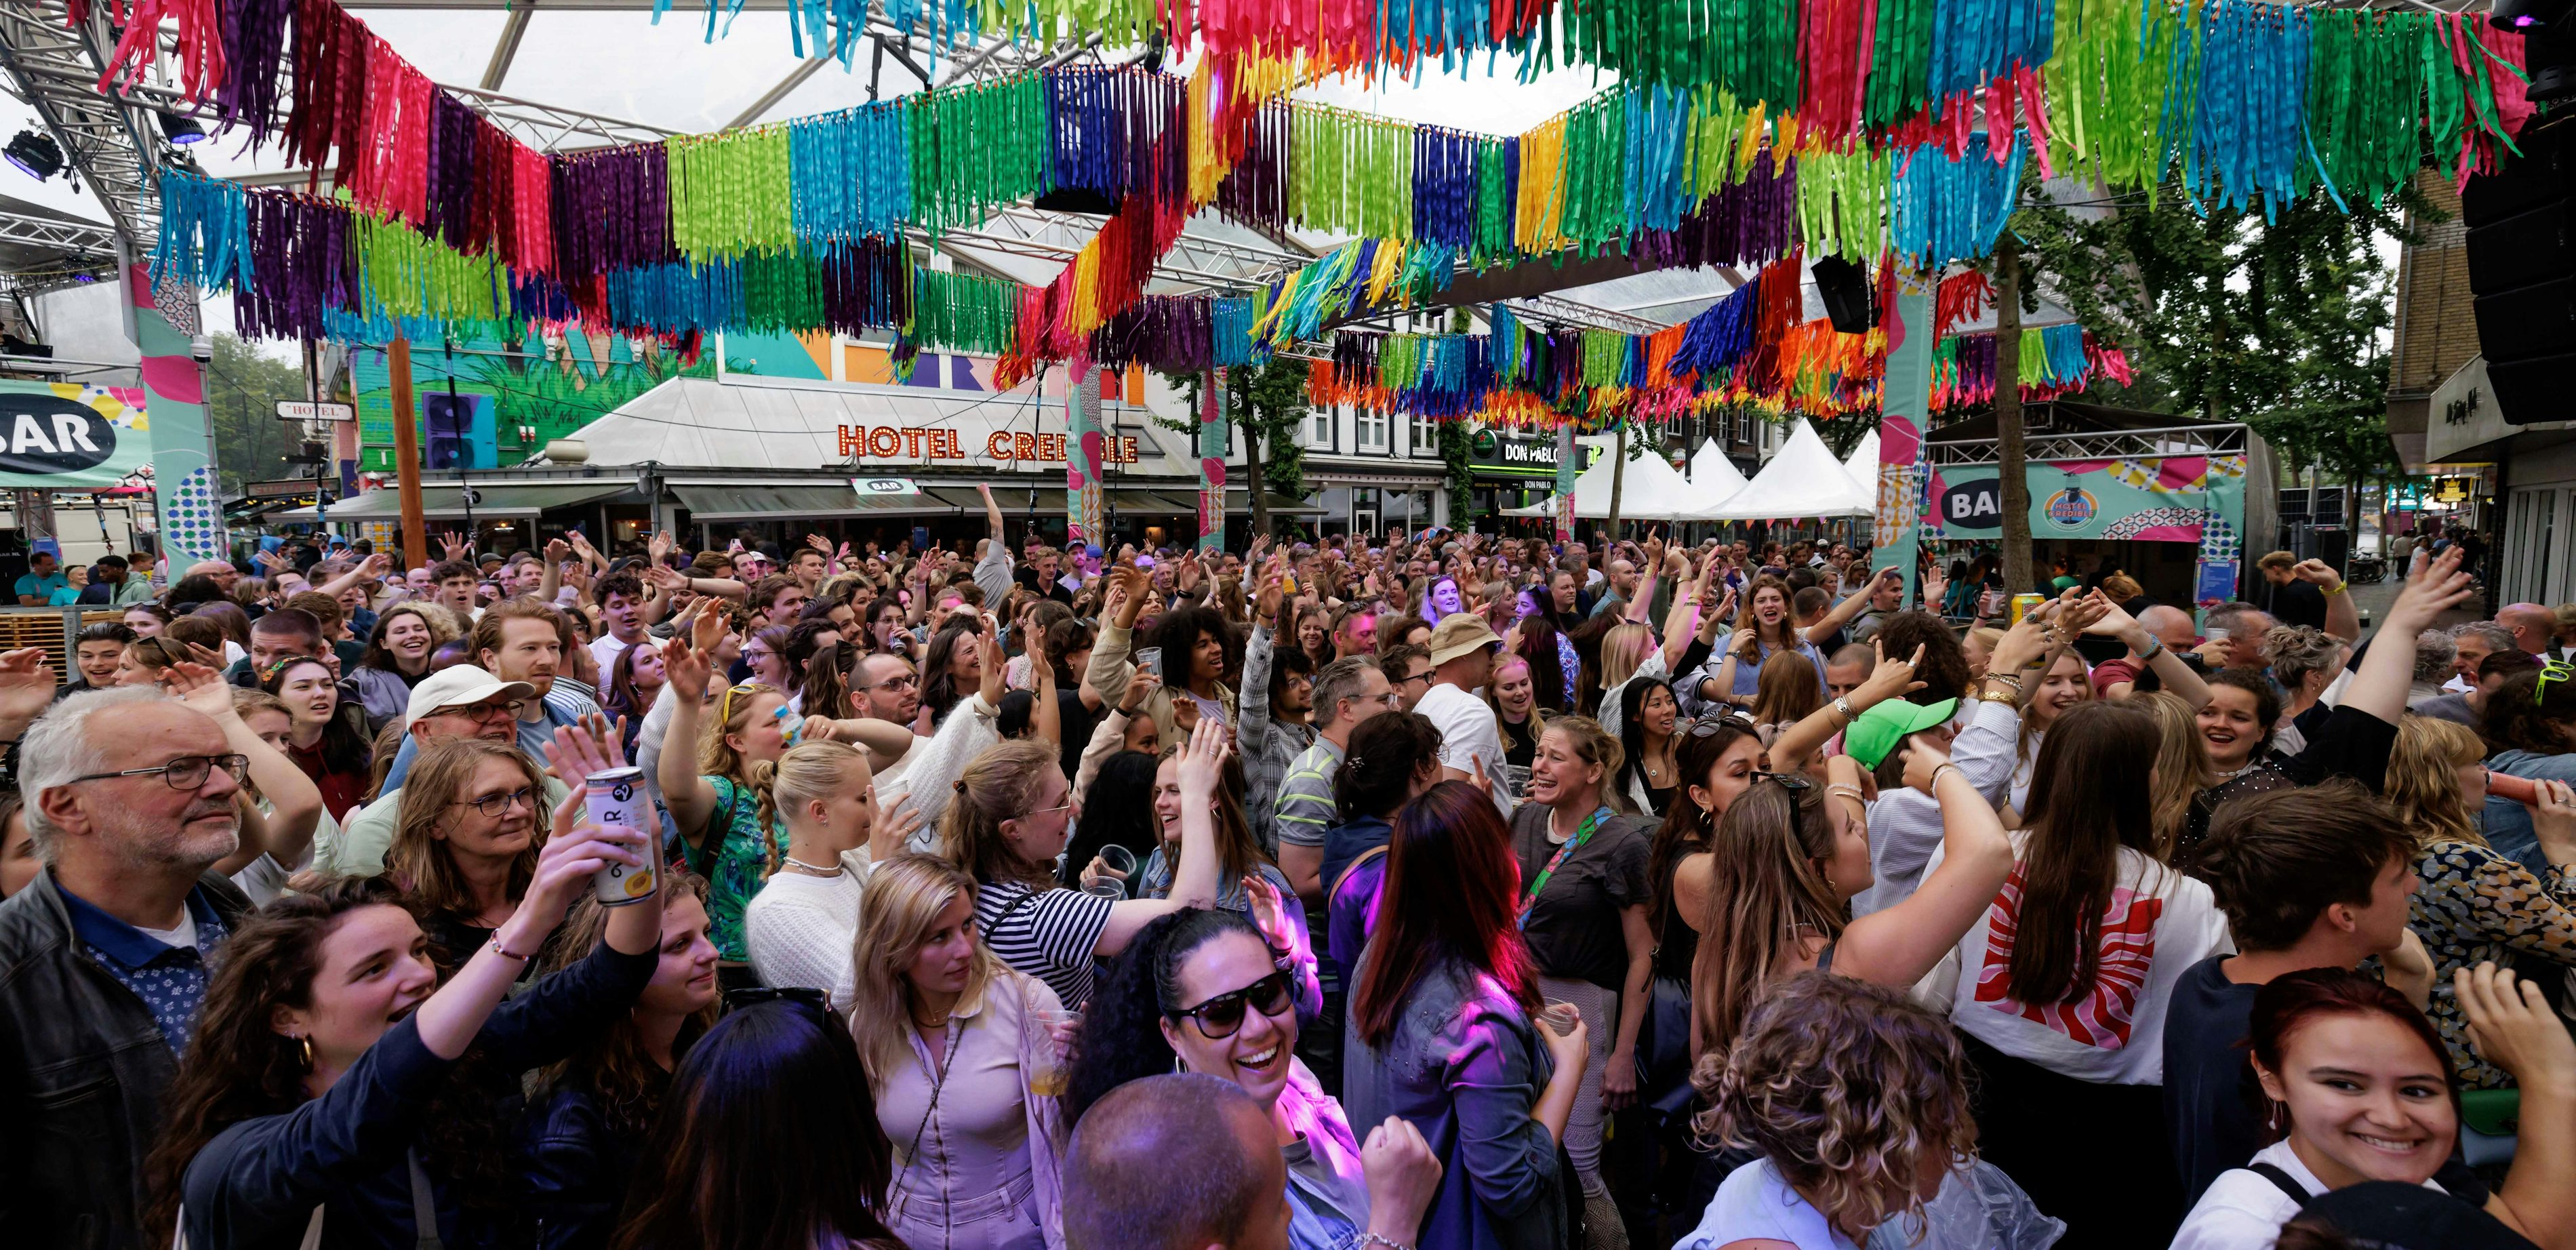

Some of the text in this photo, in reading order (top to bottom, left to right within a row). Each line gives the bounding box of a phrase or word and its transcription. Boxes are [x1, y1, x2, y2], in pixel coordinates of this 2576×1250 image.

[0, 414, 100, 453] AR
[839, 425, 965, 458] HOTEL
[1506, 444, 1527, 461] DON
[871, 482, 901, 490] BAR
[1952, 489, 2001, 519] BA
